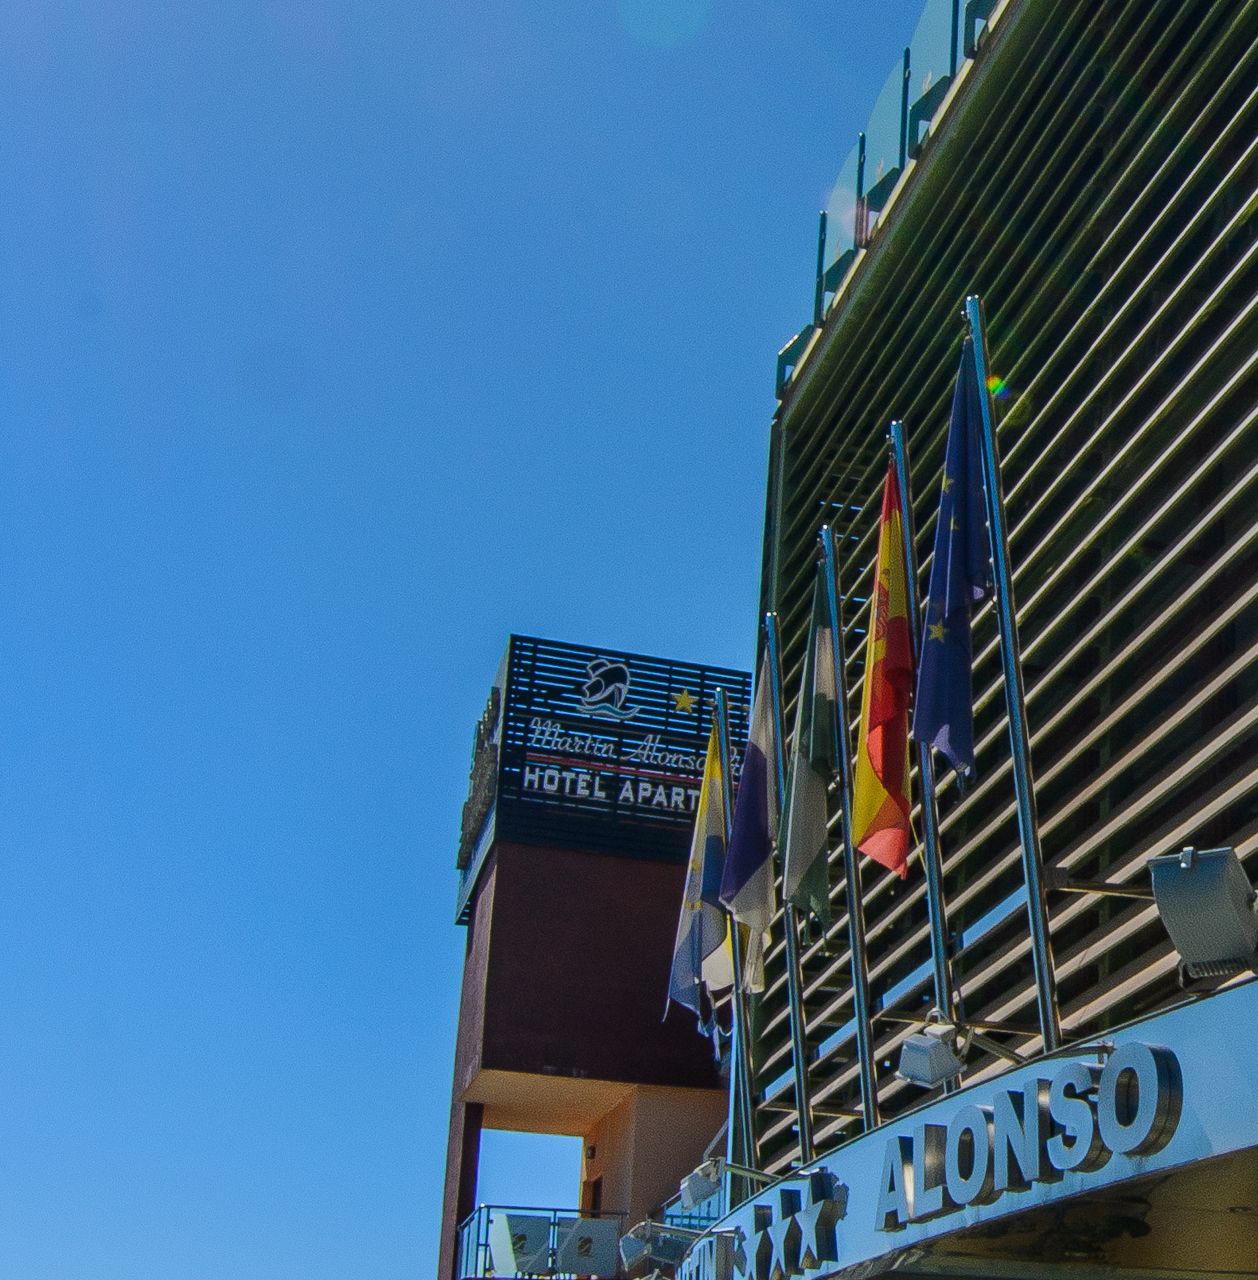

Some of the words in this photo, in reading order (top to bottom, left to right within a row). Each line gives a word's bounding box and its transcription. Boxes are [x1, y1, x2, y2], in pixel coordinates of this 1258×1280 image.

[529, 717, 616, 759] Martin
[524, 766, 606, 799] HOTEL
[618, 780, 700, 812] APART
[874, 1041, 1175, 1232] ALONSO
